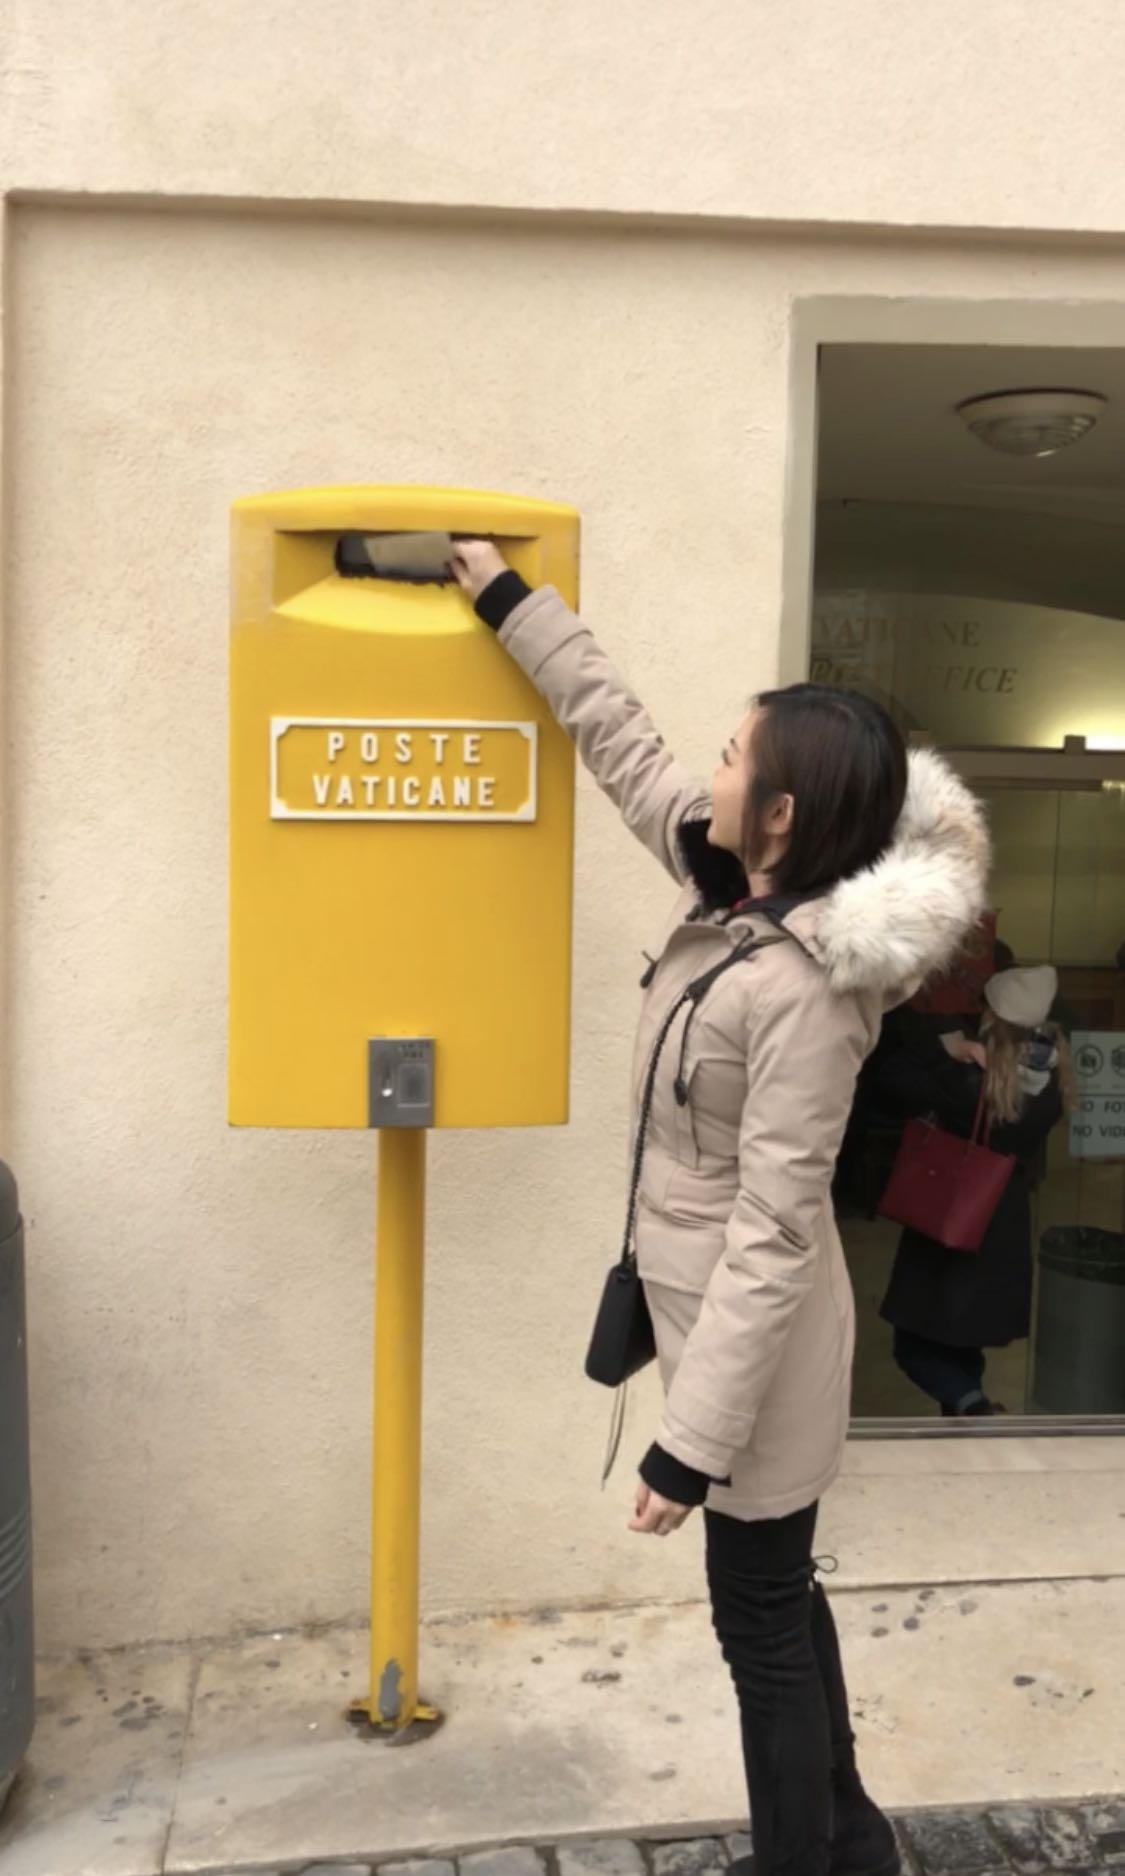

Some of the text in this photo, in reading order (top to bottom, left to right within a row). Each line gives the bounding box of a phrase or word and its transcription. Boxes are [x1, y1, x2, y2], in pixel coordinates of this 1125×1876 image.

[327, 731, 482, 765] POSTE
[312, 774, 496, 807] VATICANE
[1072, 1125, 1093, 1138] NO
